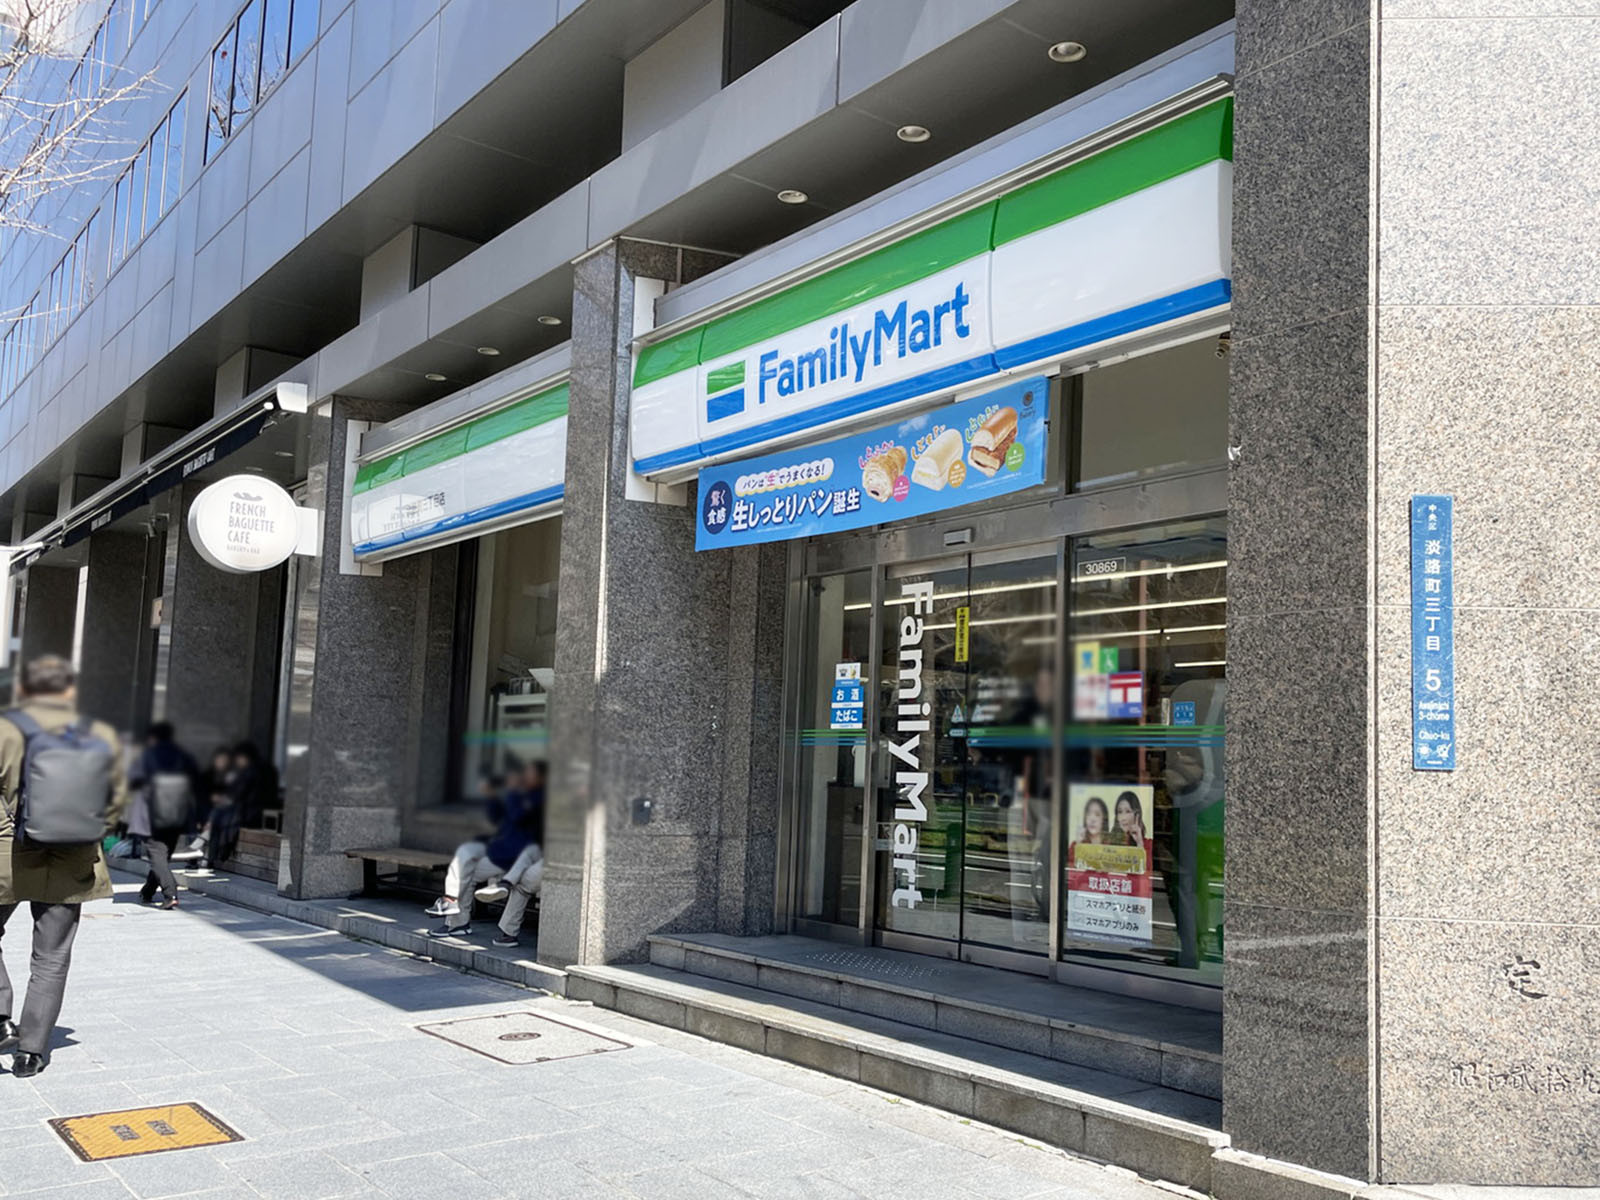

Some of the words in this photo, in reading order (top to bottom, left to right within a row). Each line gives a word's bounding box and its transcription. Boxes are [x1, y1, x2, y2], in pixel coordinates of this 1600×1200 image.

[758, 281, 969, 404] FamilyMart
[229, 501, 267, 517] FRENCH
[732, 488, 862, 532] 生しっとりパン誕生
[228, 515, 275, 533] BAGUETTE
[1085, 560, 1117, 575] 30869
[1424, 539, 1442, 651] 淡路町三丁目
[1425, 669, 1442, 692] 5
[835, 709, 858, 722] たばこ
[888, 581, 932, 909] FamilyMart
[1088, 876, 1133, 894] 取扱店舗
[1085, 916, 1140, 933] スマホアプリのみ
